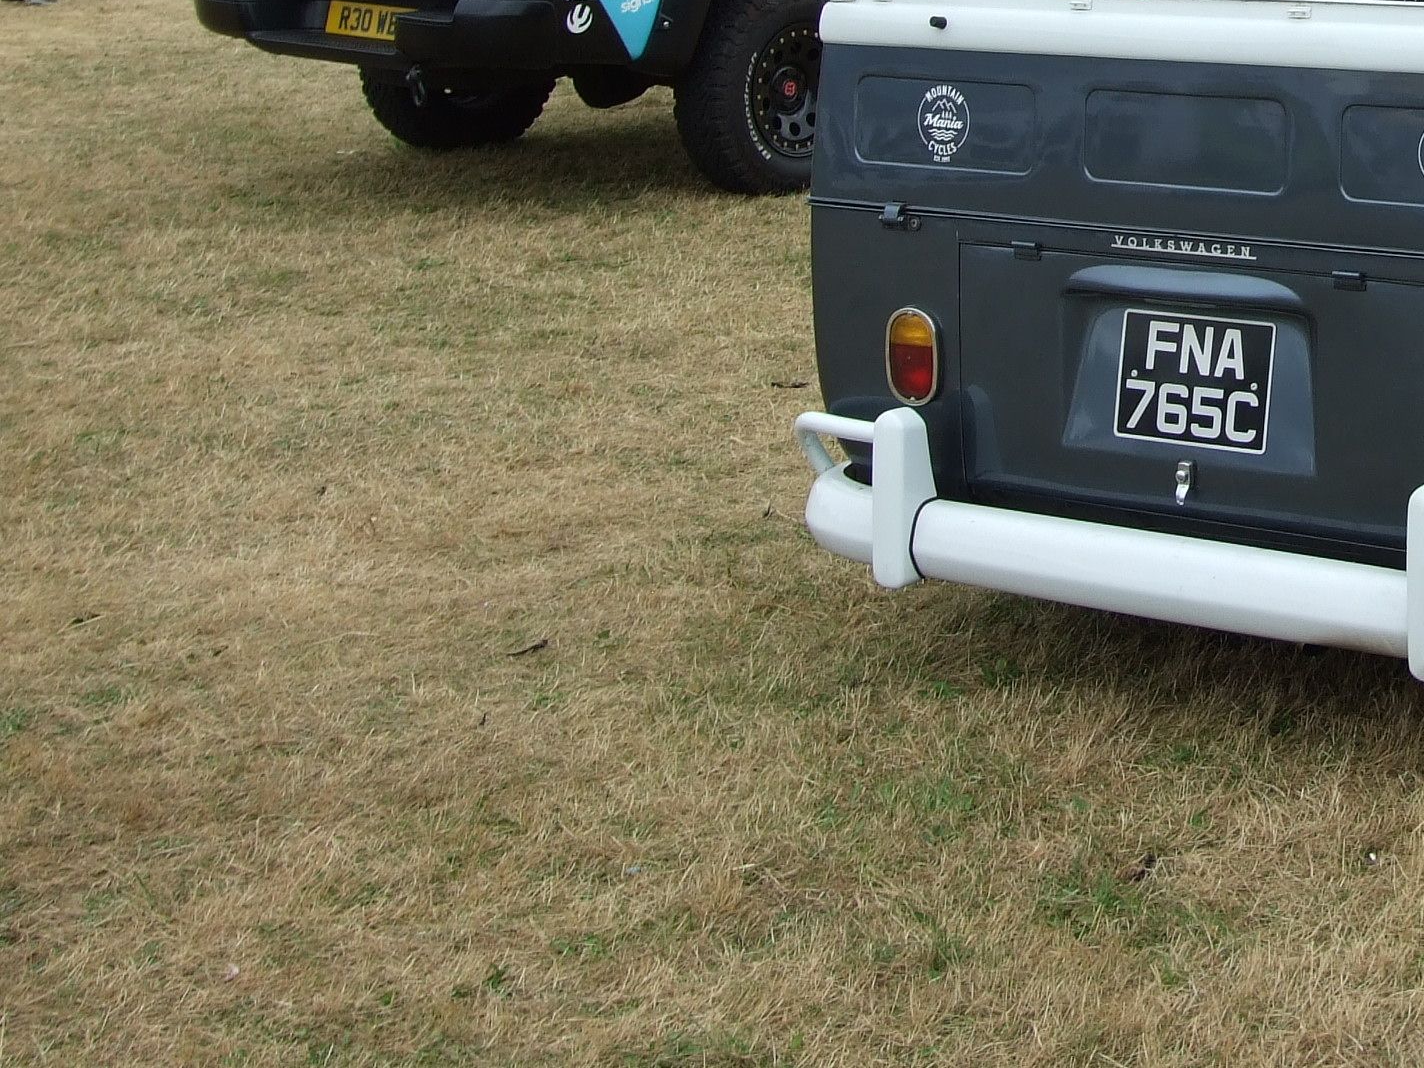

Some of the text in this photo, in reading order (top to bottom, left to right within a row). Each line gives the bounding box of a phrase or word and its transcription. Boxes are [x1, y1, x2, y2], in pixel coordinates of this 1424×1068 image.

[339, 6, 373, 32] R30
[925, 85, 965, 105] MOUNTAIN
[923, 113, 964, 130] Mania
[928, 140, 957, 156] CYCLES
[1112, 235, 1256, 259] VOLKSWAGEN
[1145, 320, 1245, 380] FNA
[1125, 378, 1259, 443] 765C
